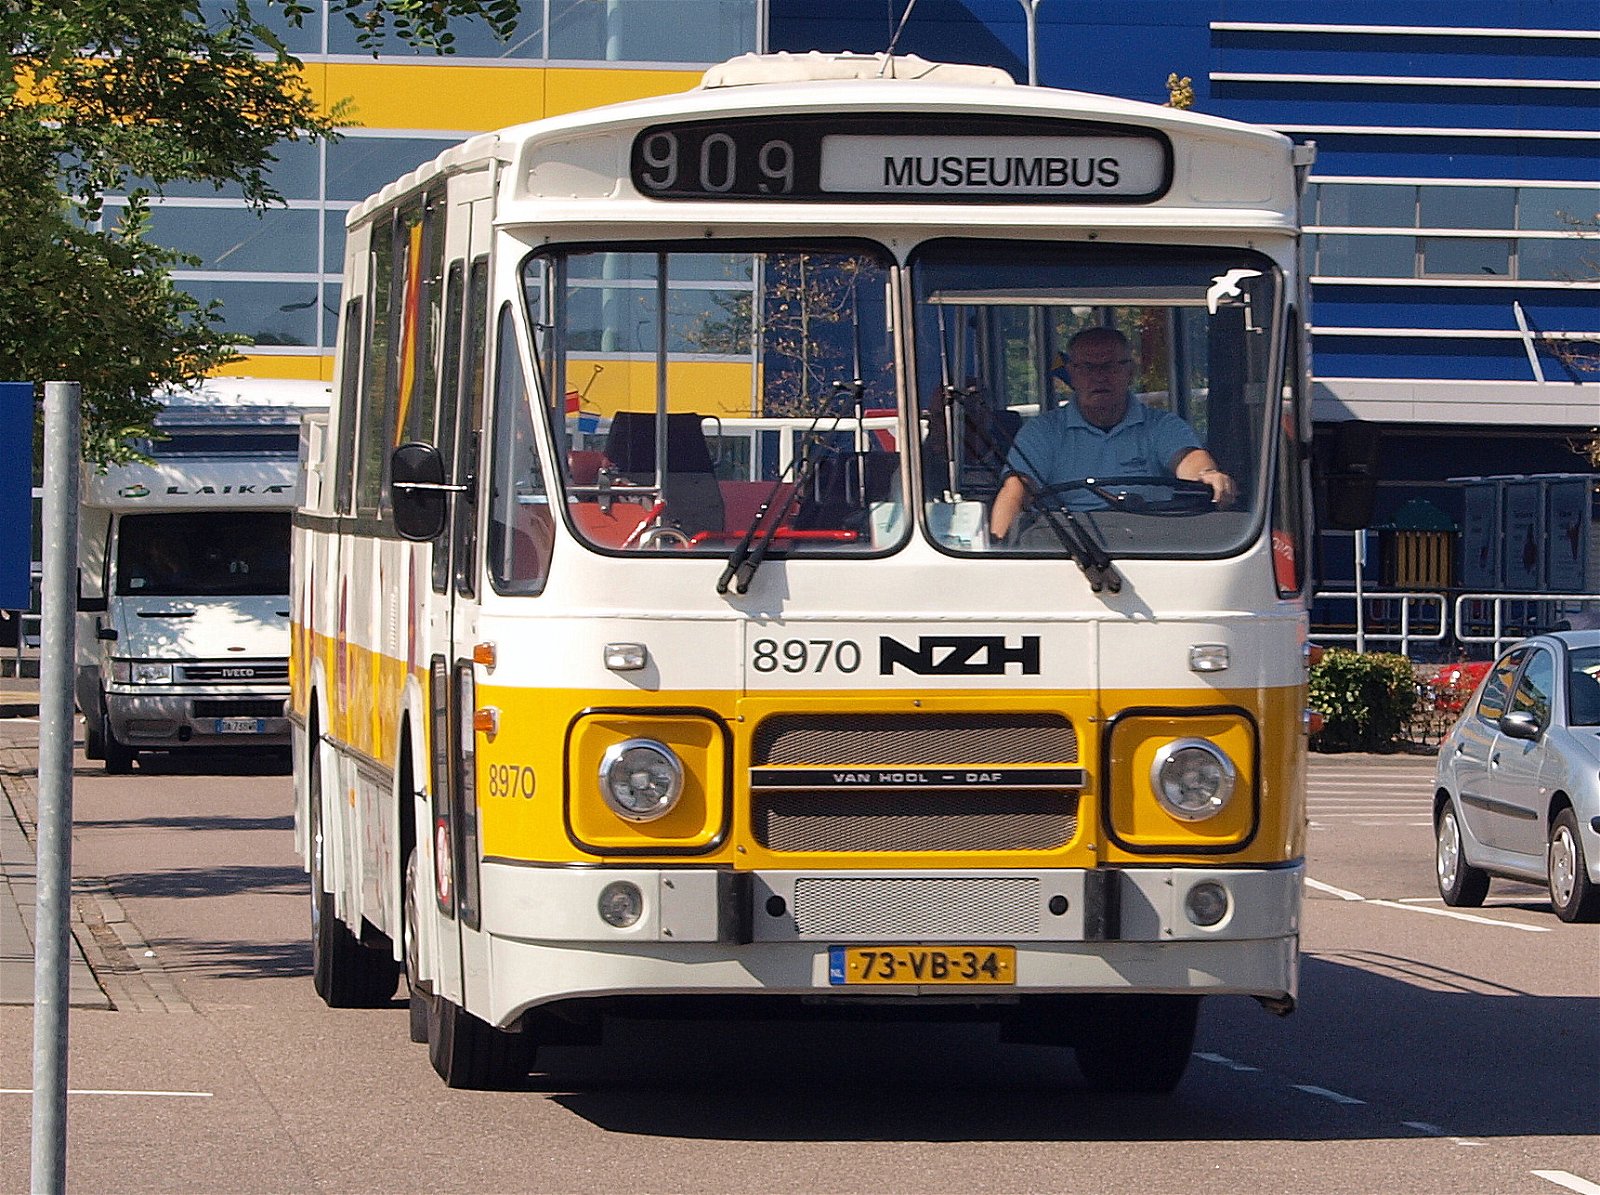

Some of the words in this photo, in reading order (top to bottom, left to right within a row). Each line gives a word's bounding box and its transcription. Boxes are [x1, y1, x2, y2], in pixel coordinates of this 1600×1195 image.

[642, 131, 794, 194] 909
[884, 156, 1119, 188] MUSEUMBUS
[166, 485, 293, 495] LAIKA
[754, 639, 861, 674] 8970
[880, 636, 1040, 676] NZH
[222, 668, 255, 677] IVECO
[489, 764, 536, 799] 8970
[833, 773, 871, 782] VAN
[879, 773, 928, 782] HOOL
[966, 773, 1002, 782] DAF
[860, 951, 998, 979] 73-VB-34
